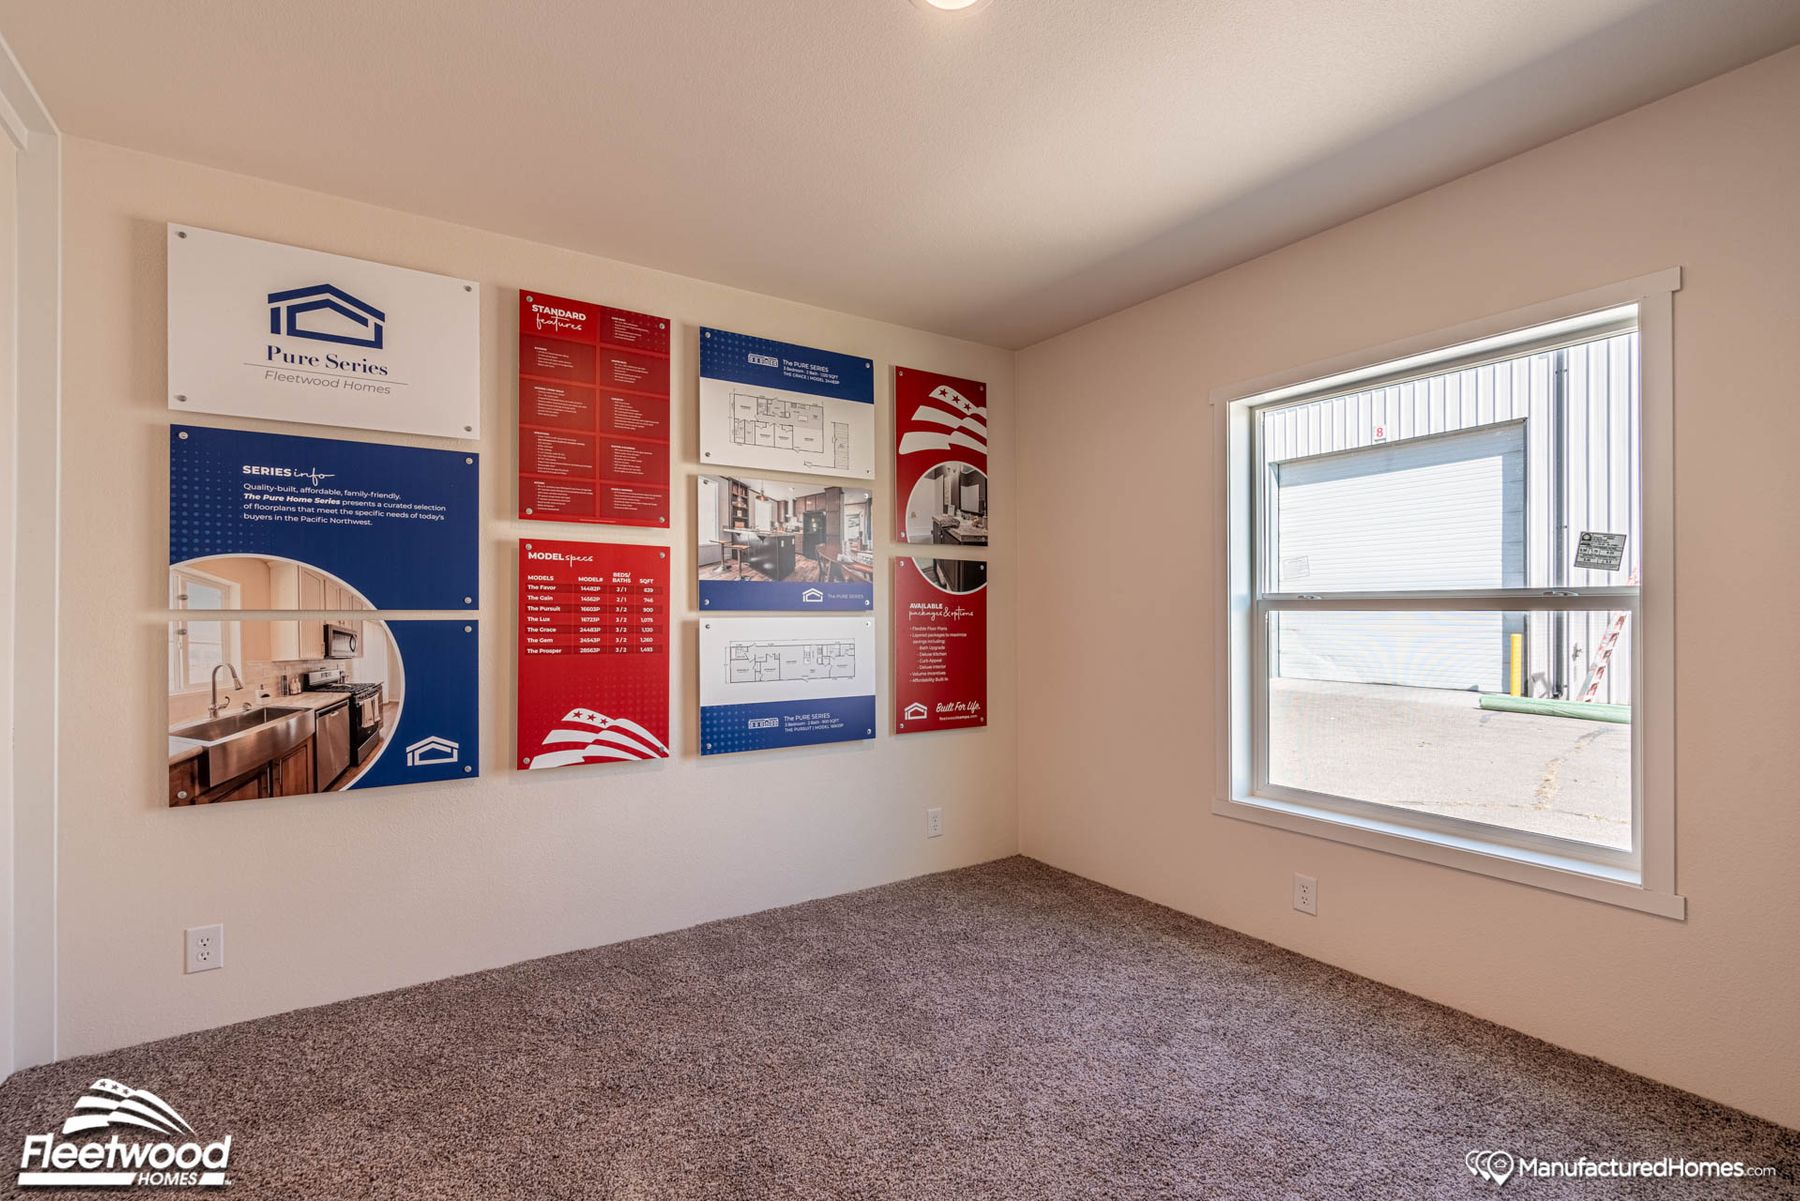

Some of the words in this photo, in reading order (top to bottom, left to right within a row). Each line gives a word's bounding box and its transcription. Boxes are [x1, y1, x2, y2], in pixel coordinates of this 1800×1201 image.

[532, 304, 587, 320] STANDARD
[536, 313, 582, 332] features
[267, 345, 320, 367] Pure
[325, 353, 388, 376] Series
[794, 361, 809, 370] PURE
[810, 364, 829, 373] SERIES
[265, 370, 340, 388] Fleetwood
[343, 380, 391, 395] Homes
[1376, 427, 1384, 438] 8
[242, 465, 292, 477] SERIES
[293, 467, 335, 487] info
[243, 482, 299, 495] Quality-built,
[300, 486, 343, 497] affordable,
[344, 489, 401, 501] family-friendly.
[243, 493, 261, 501] The
[263, 494, 285, 502] Pure
[286, 495, 312, 504] Home
[314, 497, 341, 506] Series
[342, 500, 376, 508] presents
[413, 504, 446, 512] selection
[243, 513, 273, 521] buyers
[300, 515, 328, 524] Pacific
[329, 516, 374, 526] Northwest.
[254, 503, 296, 513] floorplans
[354, 510, 385, 518] specific
[386, 511, 409, 519] needs
[419, 513, 445, 521] today's
[528, 552, 565, 561] MODEL
[565, 554, 593, 568] specs
[936, 702, 955, 713] Built
[955, 701, 967, 711] For
[811, 712, 831, 720] SERIES
